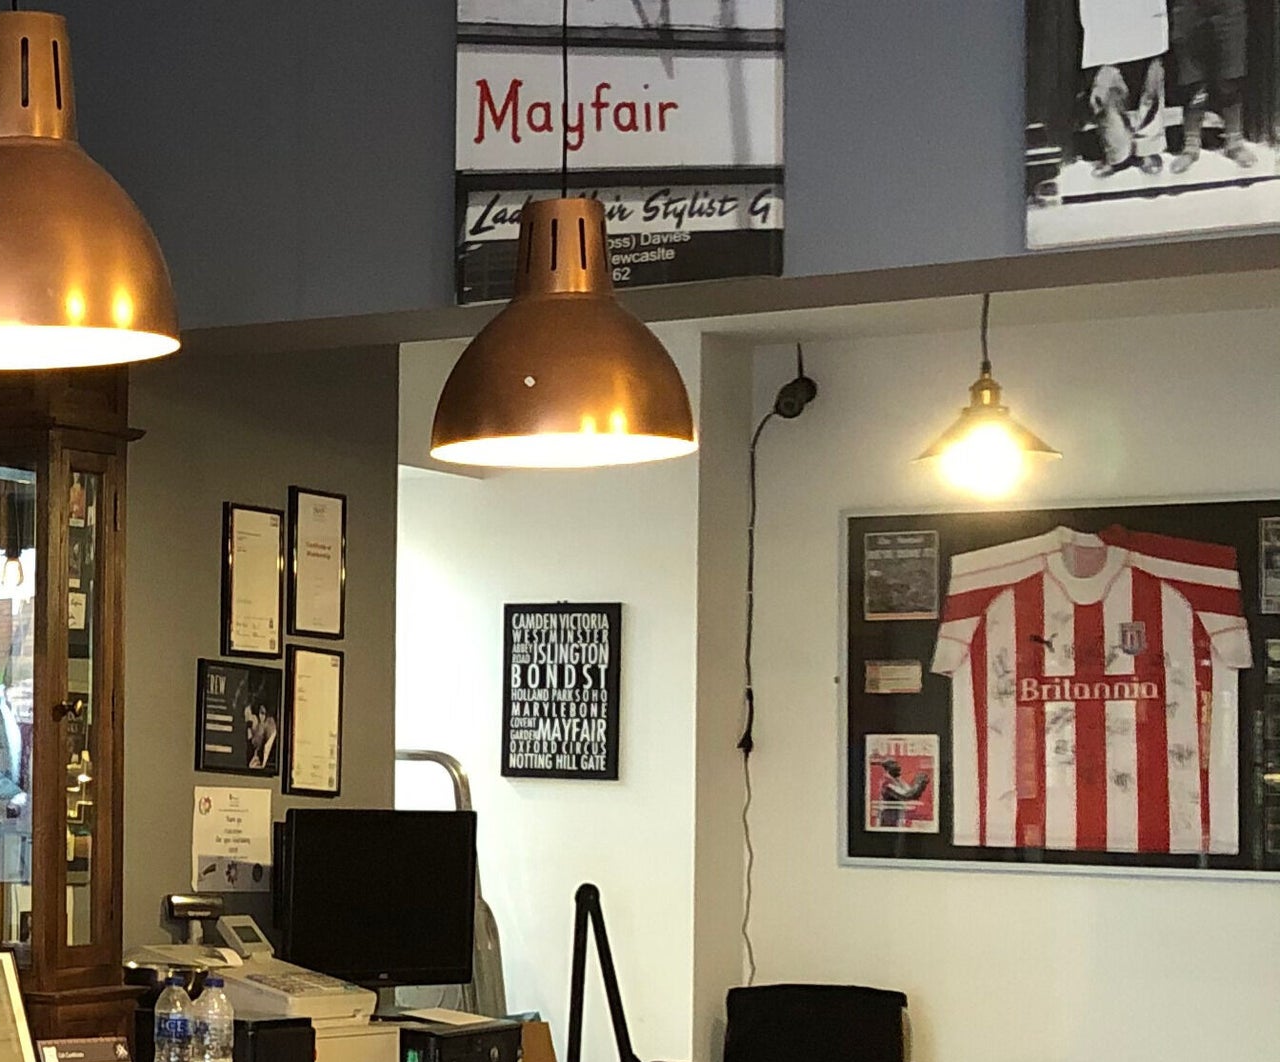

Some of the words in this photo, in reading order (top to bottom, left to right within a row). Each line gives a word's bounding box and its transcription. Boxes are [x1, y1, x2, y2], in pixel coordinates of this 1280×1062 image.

[473, 78, 679, 151] Mayfair
[642, 188, 738, 227] Stylist
[608, 234, 636, 250] oss)
[640, 231, 691, 246] Davies
[512, 613, 557, 629] CAMDEN
[559, 613, 609, 630] VICTORIA
[512, 629, 608, 643] WESTMINSTER
[533, 643, 608, 664] ISLINGTON
[511, 688, 549, 701] HOLLAND
[552, 689, 573, 701] PARK
[575, 689, 607, 702] SOHO
[1020, 676, 1159, 701] Britannia
[511, 702, 607, 718] MARYLEBONE
[538, 718, 607, 742] MAYFAIR
[510, 740, 557, 754] OXFORD
[562, 741, 607, 754] CIRCUS
[509, 753, 553, 769] NOTTING
[556, 754, 578, 770] HILL
[581, 755, 606, 771] GATE
